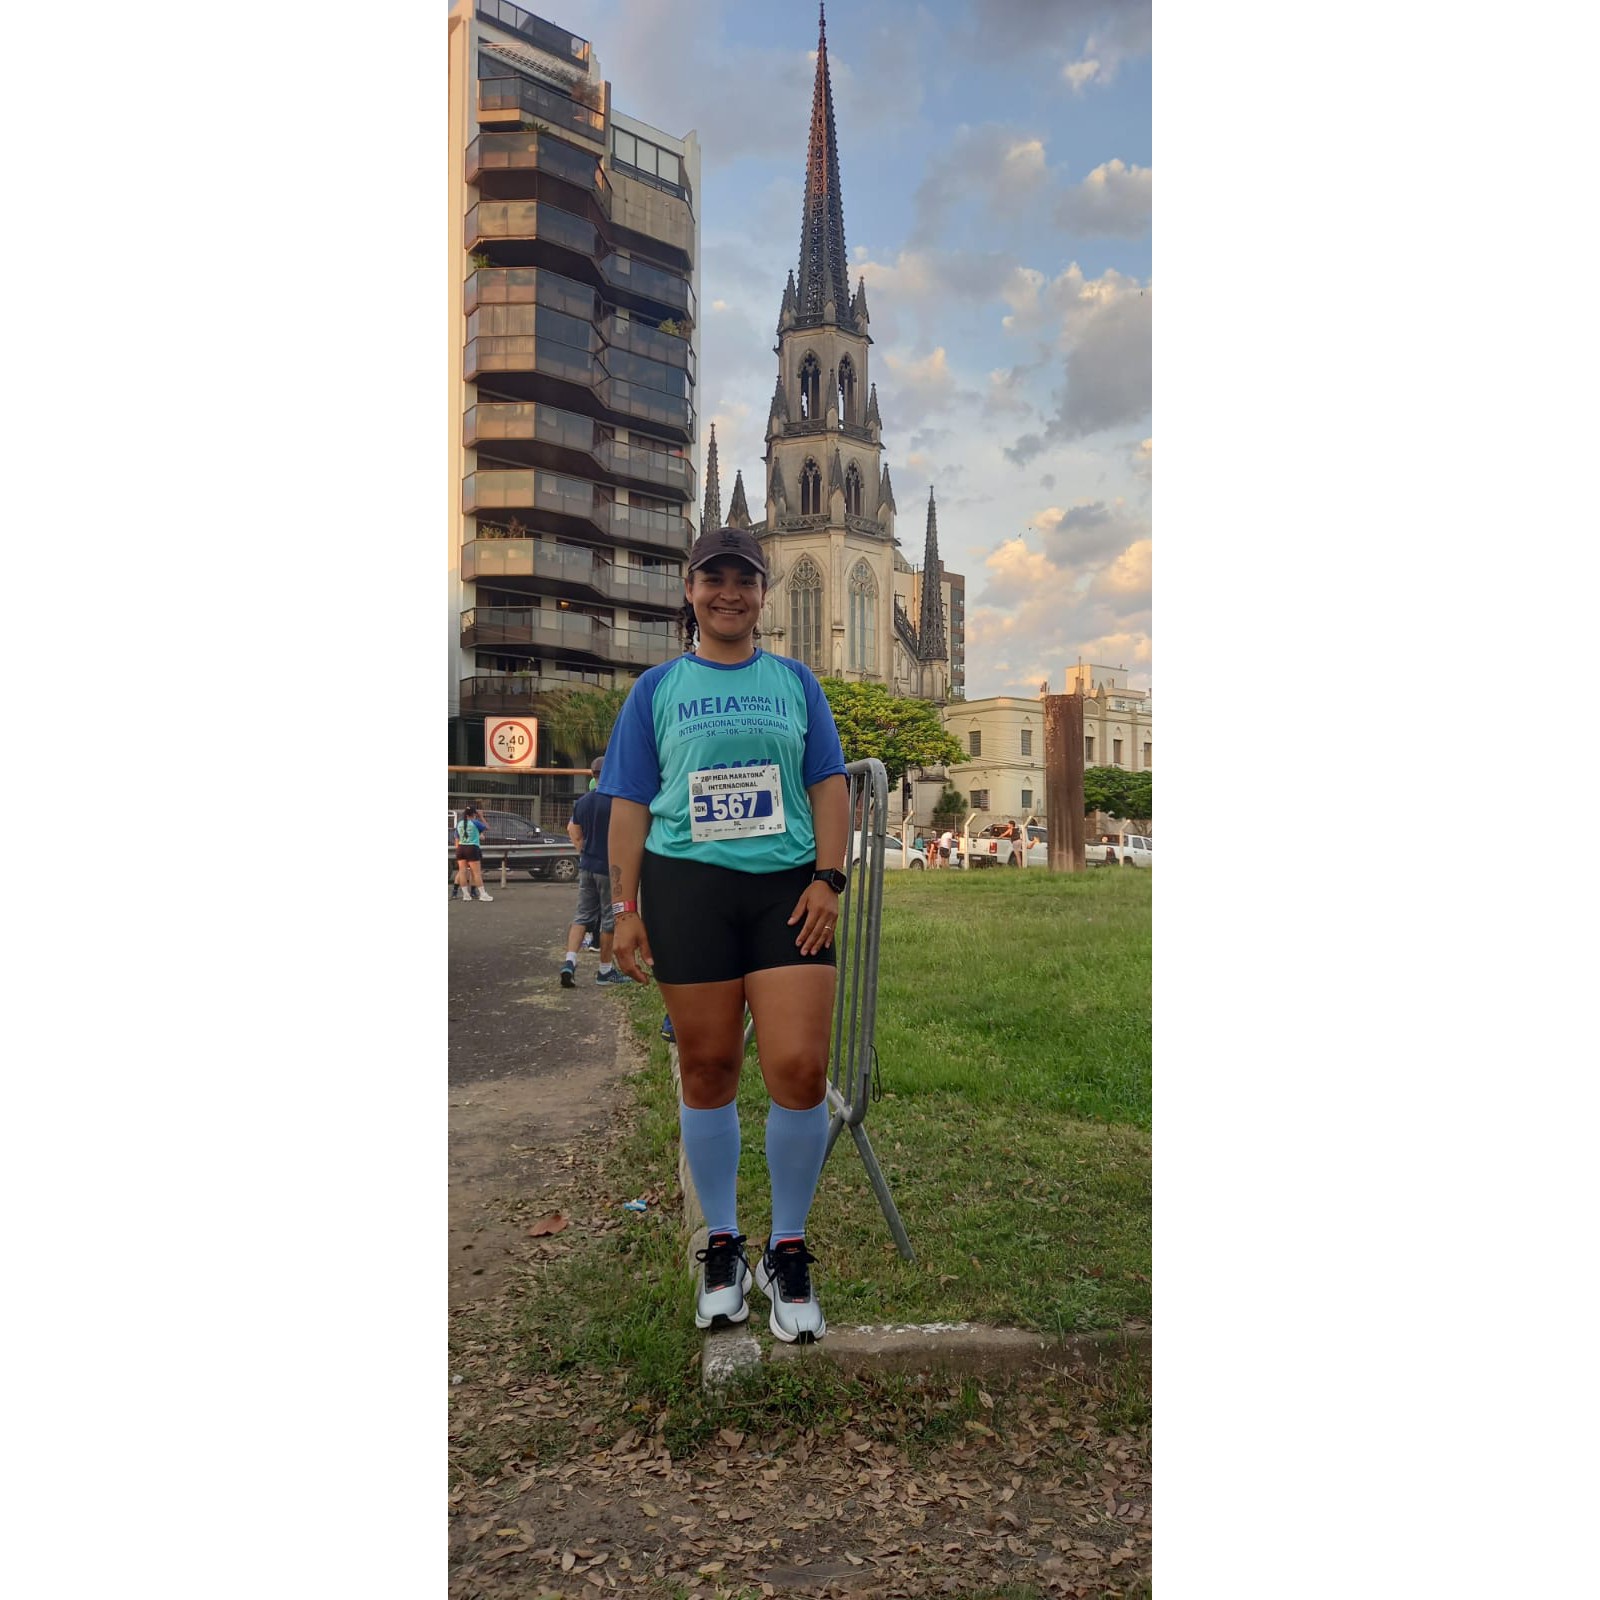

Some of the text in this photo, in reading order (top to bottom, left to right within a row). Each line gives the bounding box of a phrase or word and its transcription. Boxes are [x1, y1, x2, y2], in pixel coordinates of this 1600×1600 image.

[740, 695, 771, 704] MARA
[678, 696, 741, 721] MEIA
[742, 703, 771, 712] TONA
[678, 719, 736, 737] INTERNACIONAL
[741, 718, 789, 732] URUGUAIANA
[498, 734, 525, 747] 2,40
[729, 771, 764, 779] MARATONA
[708, 780, 758, 791] INTERNACIONAL
[711, 791, 758, 820] 567
